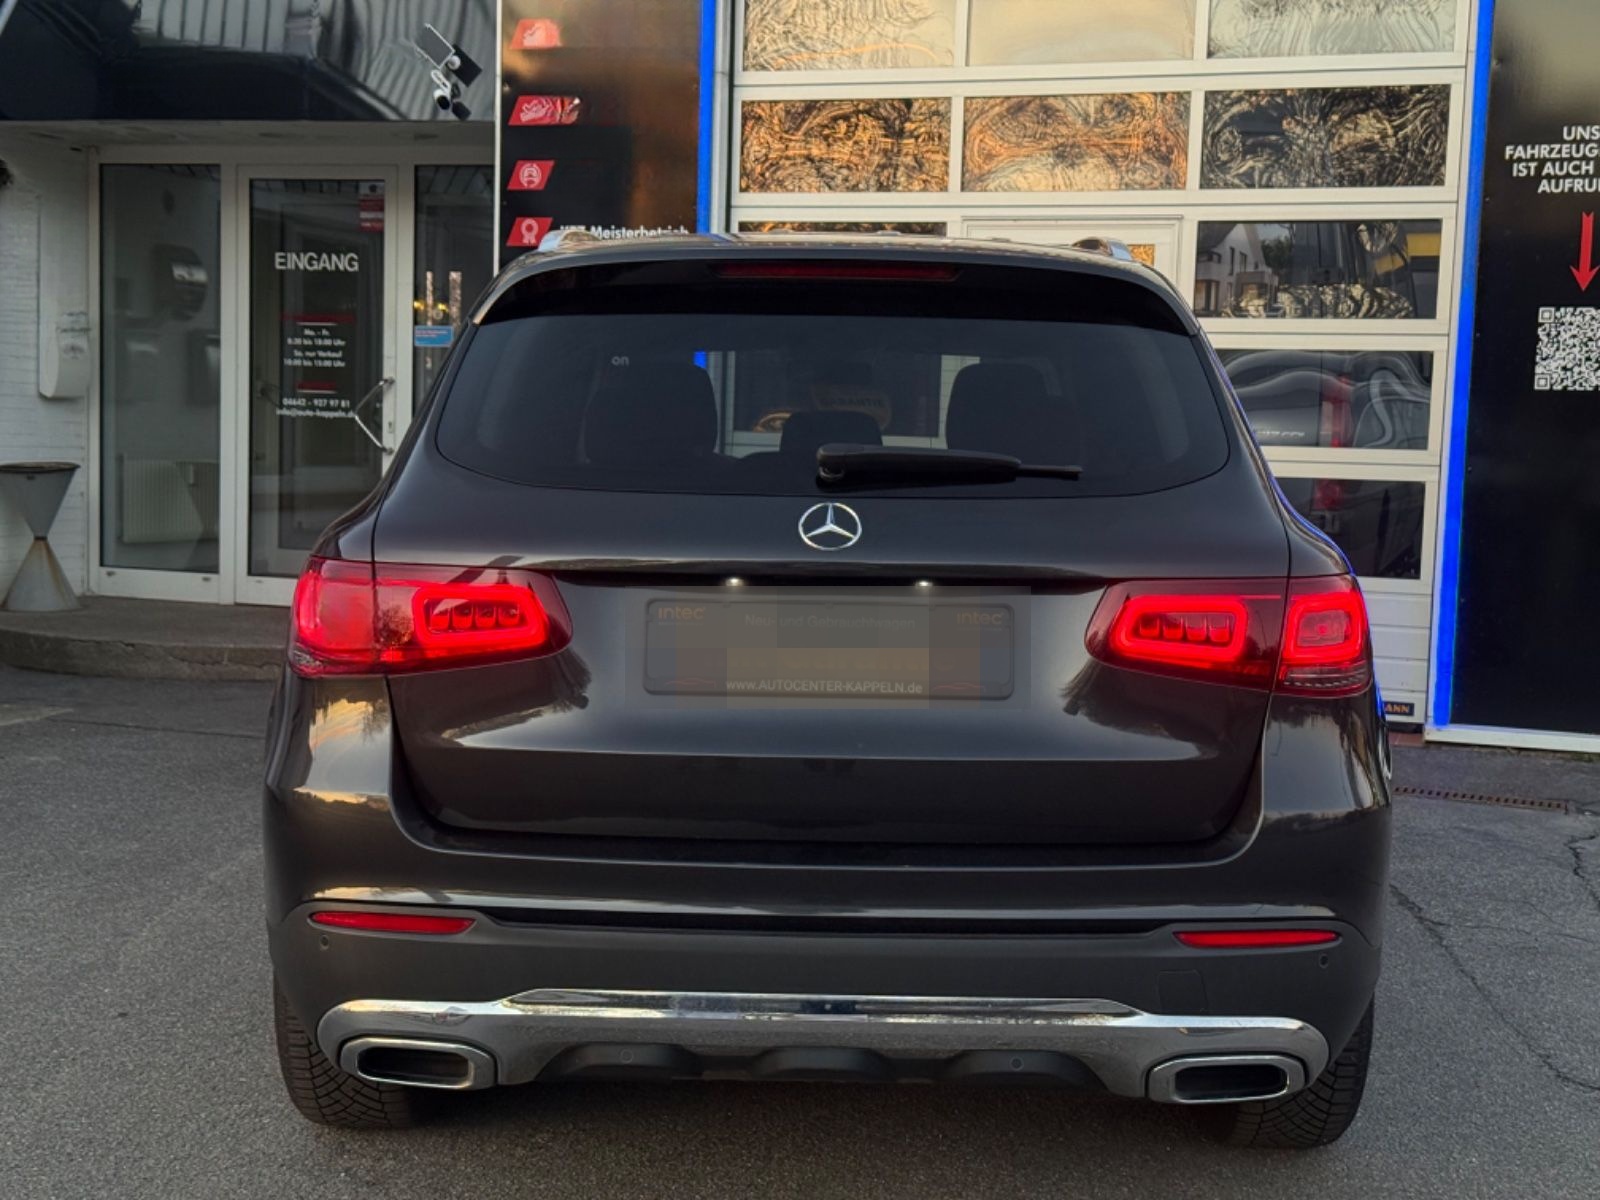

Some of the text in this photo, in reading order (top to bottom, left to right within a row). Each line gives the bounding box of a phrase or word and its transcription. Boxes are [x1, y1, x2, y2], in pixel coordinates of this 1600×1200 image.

[1505, 143, 1600, 159] FAHRZEUG
[1512, 161, 1594, 177] IST AUCH
[1537, 178, 1600, 193] AUFRU
[590, 225, 689, 239] Meisterbetb
[274, 251, 360, 272] EINGANG
[726, 678, 923, 695] www.AUTOCENTER-KAPPELN.de
